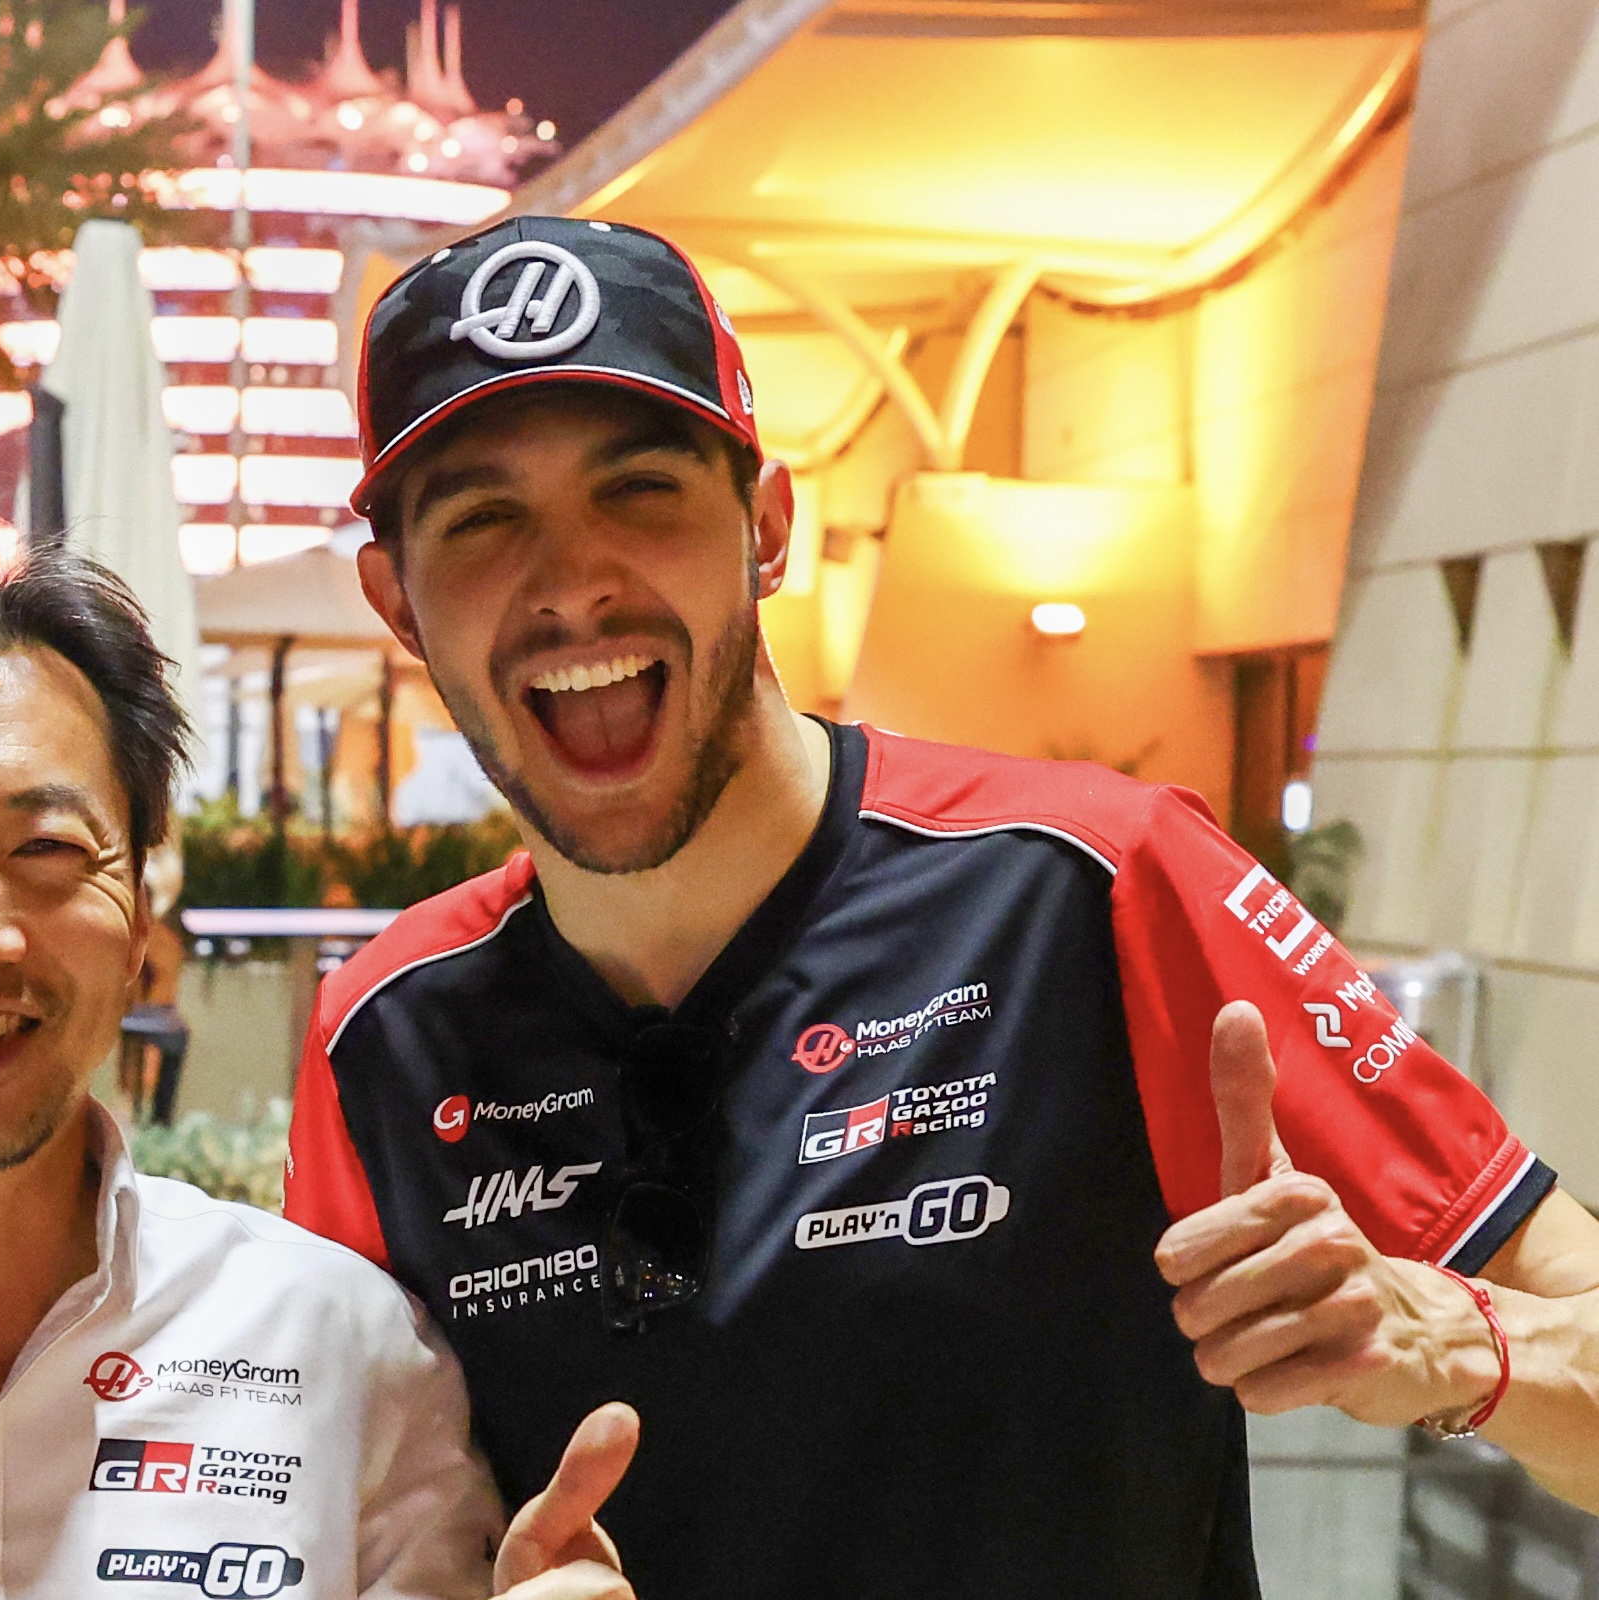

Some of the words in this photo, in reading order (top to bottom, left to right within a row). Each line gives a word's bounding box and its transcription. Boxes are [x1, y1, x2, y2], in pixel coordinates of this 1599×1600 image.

[856, 982, 988, 1041] MoneyGram
[857, 1034, 912, 1058] HAAS
[932, 1005, 992, 1029] TEAM
[473, 1087, 595, 1122] MoneyGram
[892, 1072, 997, 1105] TOYOTA
[890, 1109, 986, 1138] Racing
[891, 1091, 988, 1122] GAZOO
[804, 1116, 884, 1159] GR
[442, 1161, 603, 1230] HAAS
[908, 1182, 989, 1239] GO
[449, 1244, 598, 1299] ORION180
[453, 1273, 602, 1319] INSURANCE
[157, 1359, 300, 1385] MoneyGram
[157, 1381, 214, 1398] HAAS
[220, 1386, 239, 1399] F1
[242, 1388, 302, 1406] TEAM
[199, 1463, 292, 1484] GAZOO
[201, 1446, 303, 1468] TOYOTA
[93, 1459, 187, 1491] GR
[196, 1479, 288, 1505] Racing
[203, 1545, 287, 1597] GO
